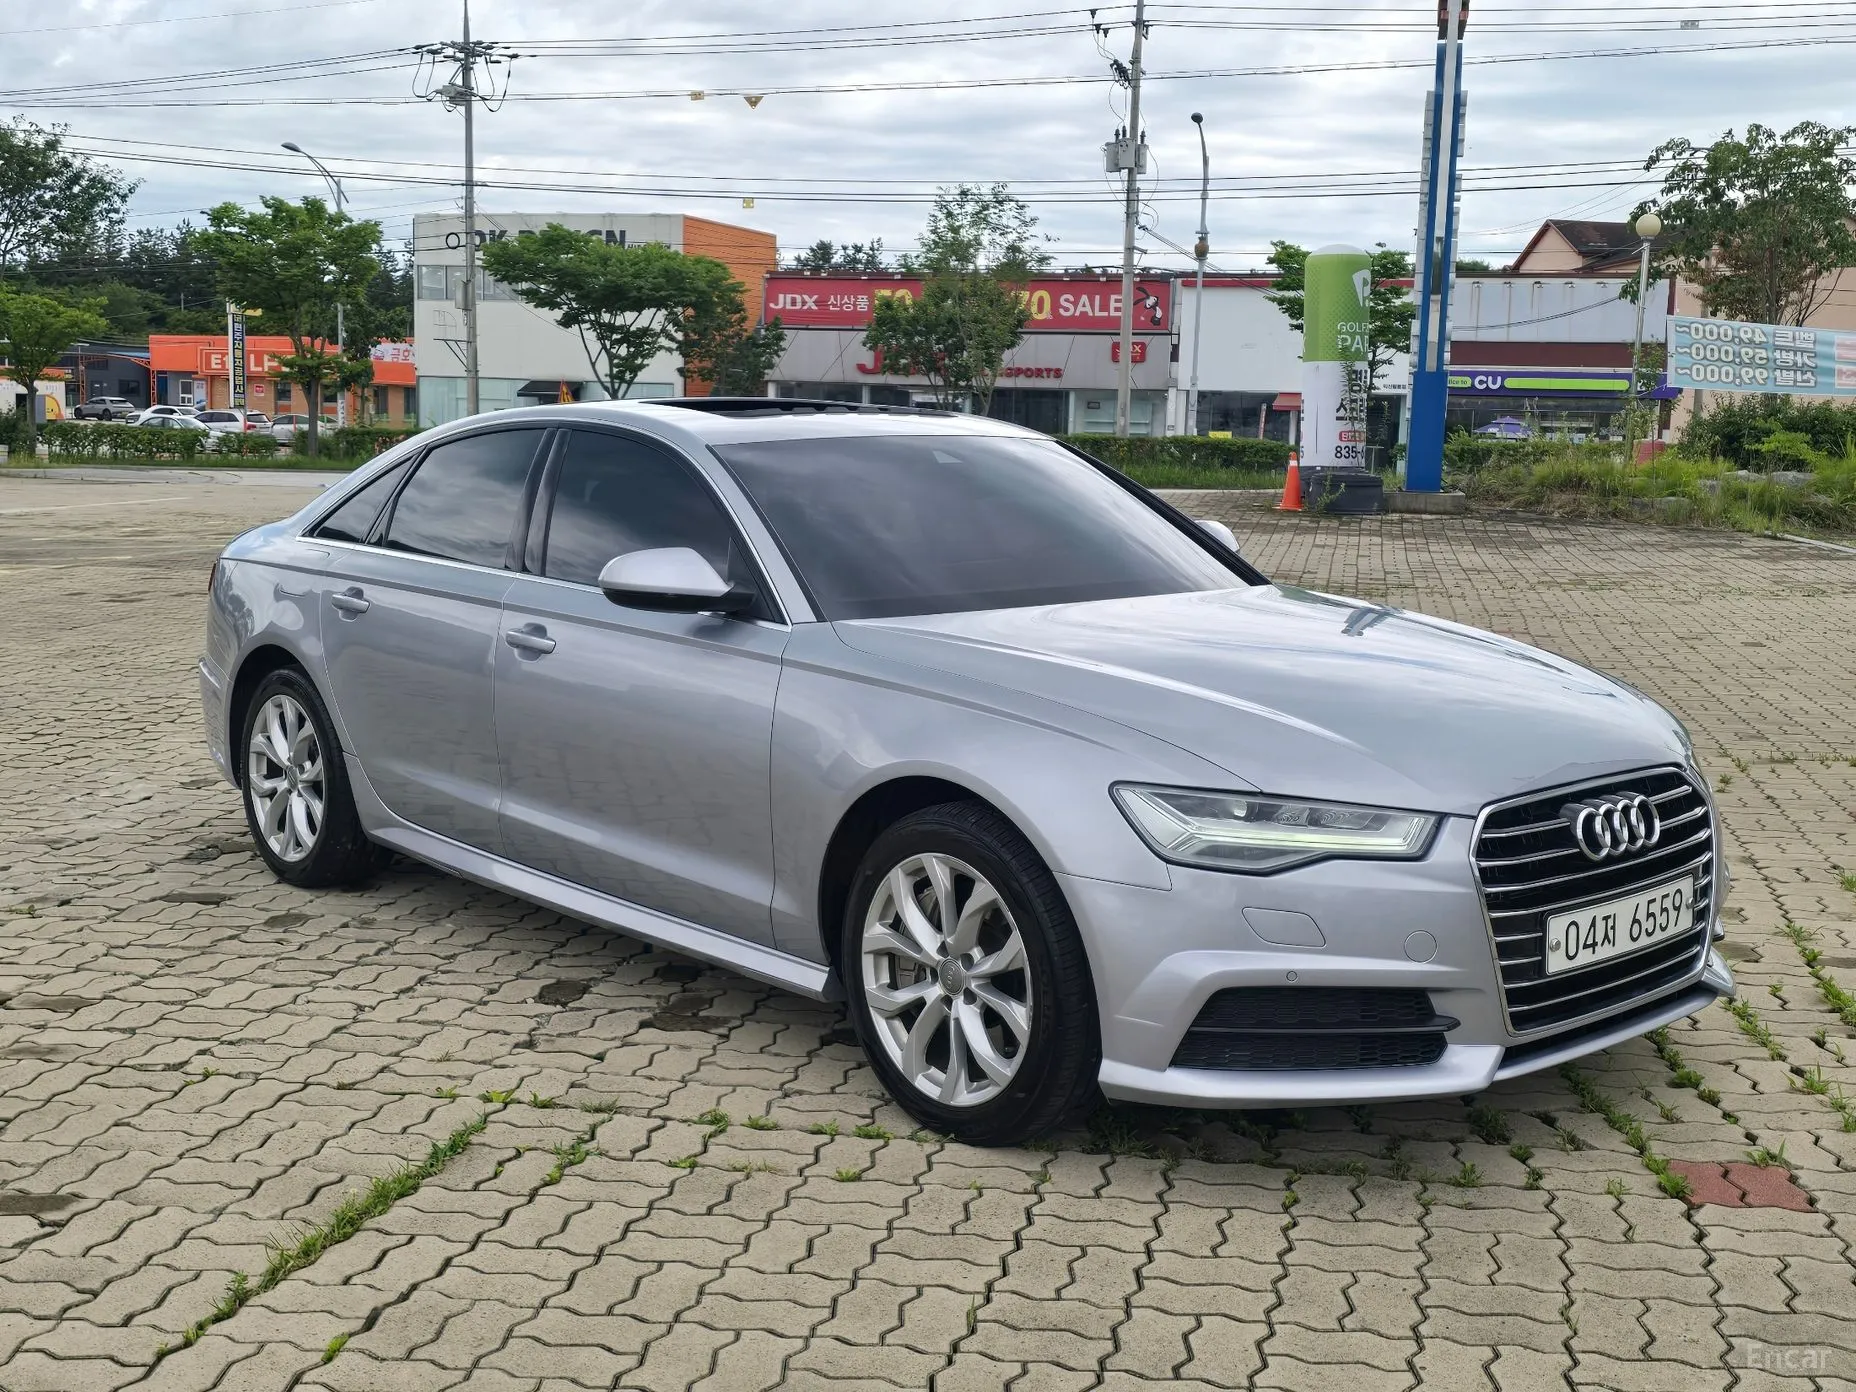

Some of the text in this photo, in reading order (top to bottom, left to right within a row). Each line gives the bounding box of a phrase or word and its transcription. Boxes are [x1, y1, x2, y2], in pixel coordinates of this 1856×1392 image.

[769, 293, 819, 310] JDX
[828, 294, 869, 312] 신상품
[1059, 294, 1122, 317] SALE
[1001, 367, 1064, 379] SPORTS
[1474, 375, 1502, 390] CU
[1564, 887, 1684, 961] 04저 6559
